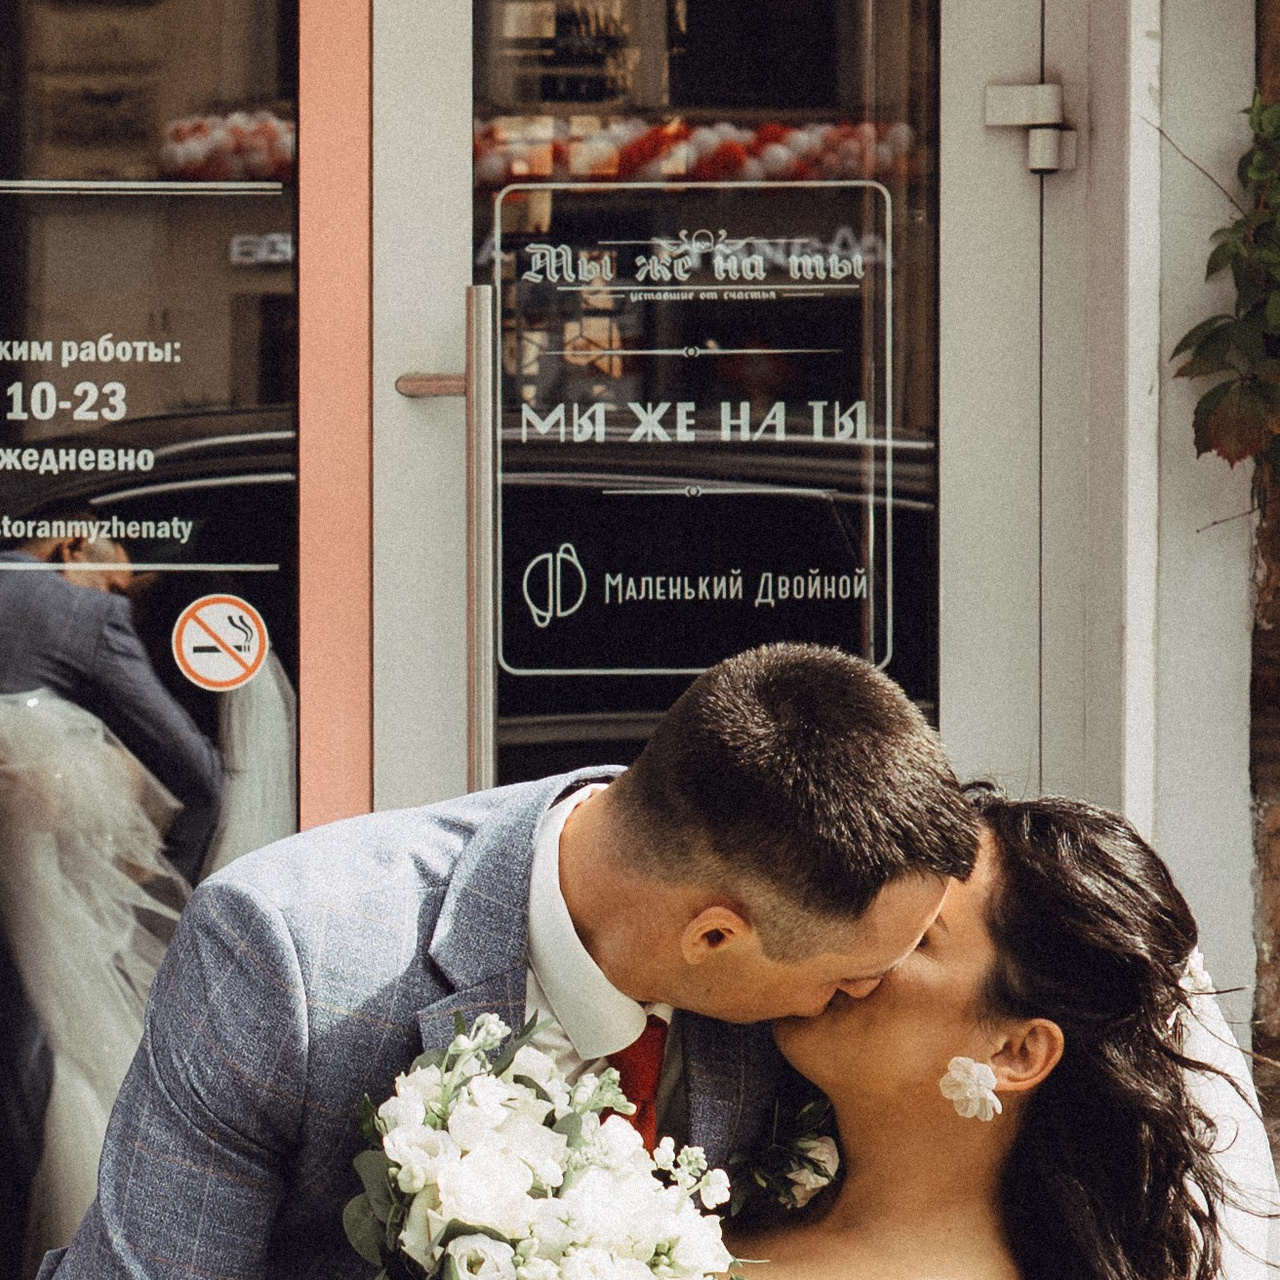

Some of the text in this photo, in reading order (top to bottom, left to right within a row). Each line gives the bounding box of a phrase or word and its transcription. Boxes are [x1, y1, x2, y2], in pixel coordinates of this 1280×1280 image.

[635, 254, 693, 282] же
[713, 253, 768, 282] на
[699, 291, 718, 300] от
[61, 333, 182, 368] работы:
[6, 381, 127, 421] 10-23
[521, 400, 868, 444] МЫ ЖЕ НА ТЫ
